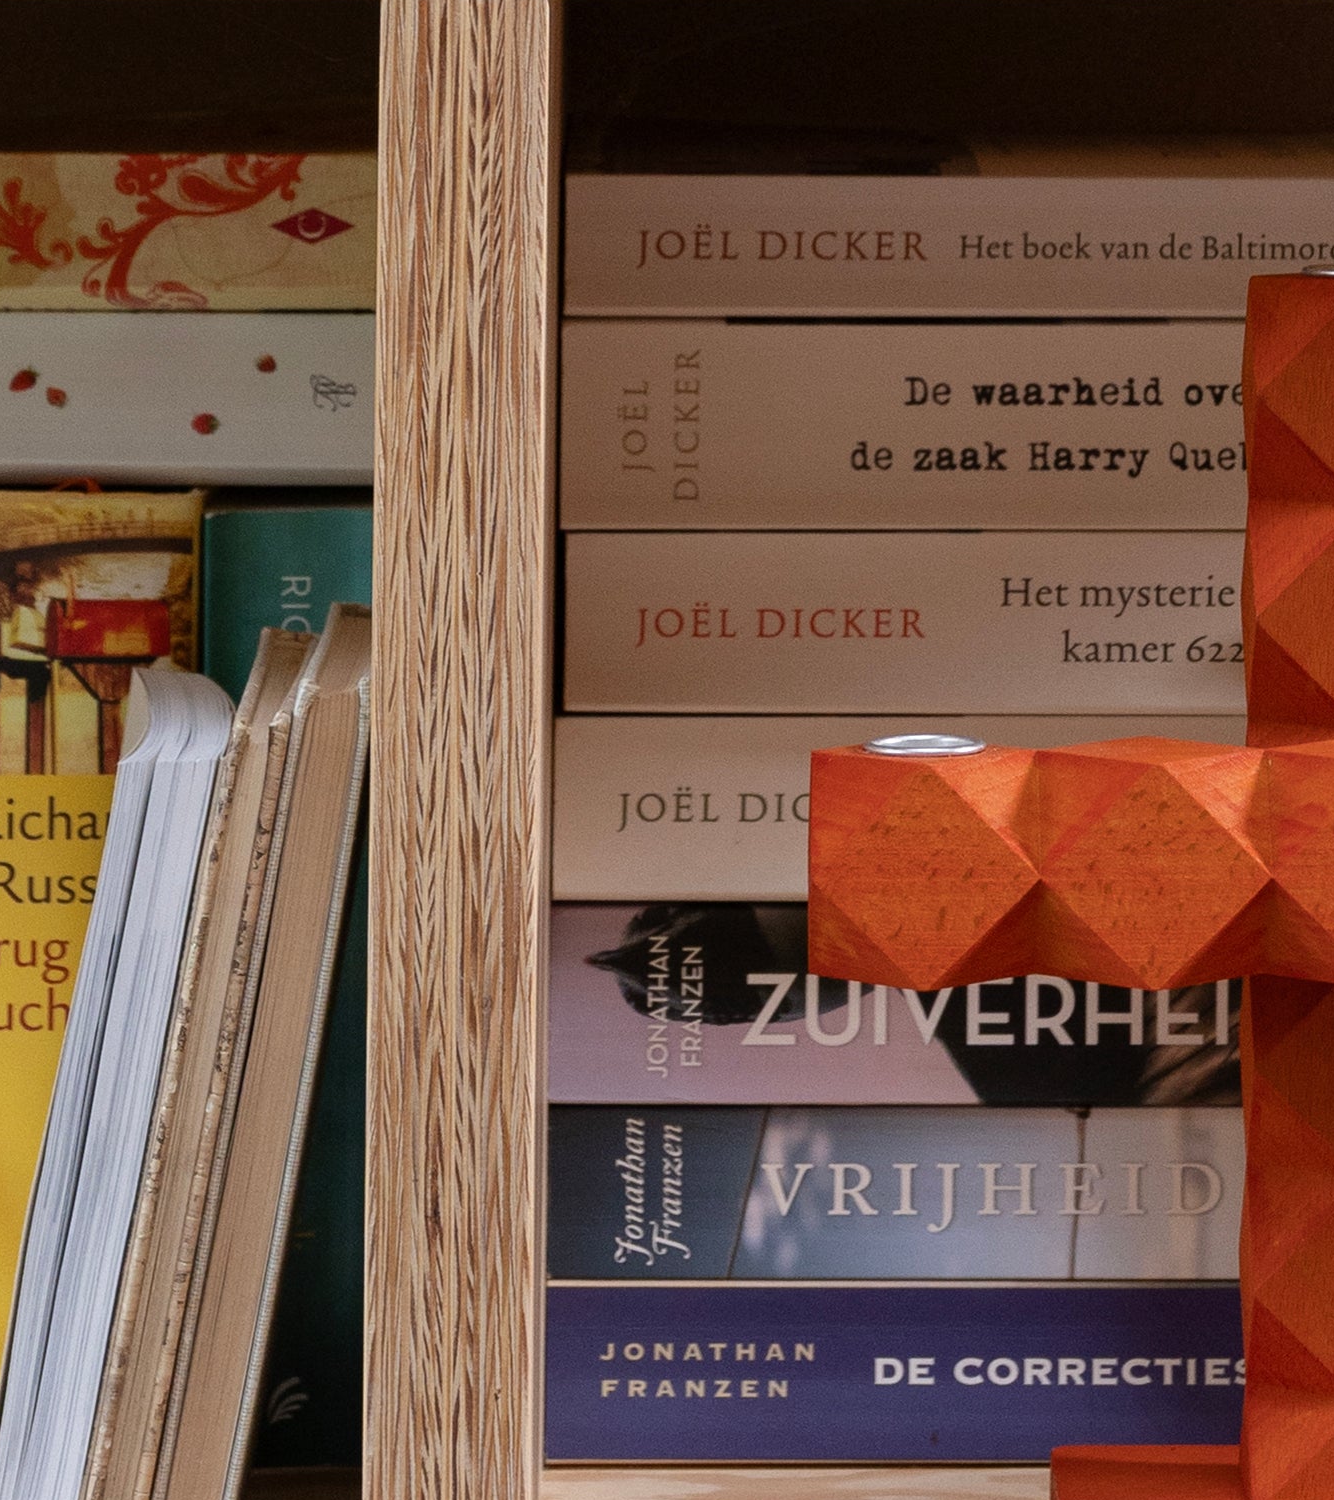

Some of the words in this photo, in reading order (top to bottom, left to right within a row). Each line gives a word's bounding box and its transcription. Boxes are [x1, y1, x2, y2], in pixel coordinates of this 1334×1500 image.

[638, 222, 739, 270] JOËL
[757, 227, 928, 263] DICKER
[959, 233, 1014, 260] Het
[1021, 232, 1091, 260] boek
[1101, 237, 1153, 261] van
[1159, 232, 1194, 261] de
[763, 1163, 1224, 1233] VRIJHEID
[600, 1343, 817, 1362] JONATHAN
[874, 1358, 935, 1386] DE
[602, 1380, 790, 1398] FRANZEN
